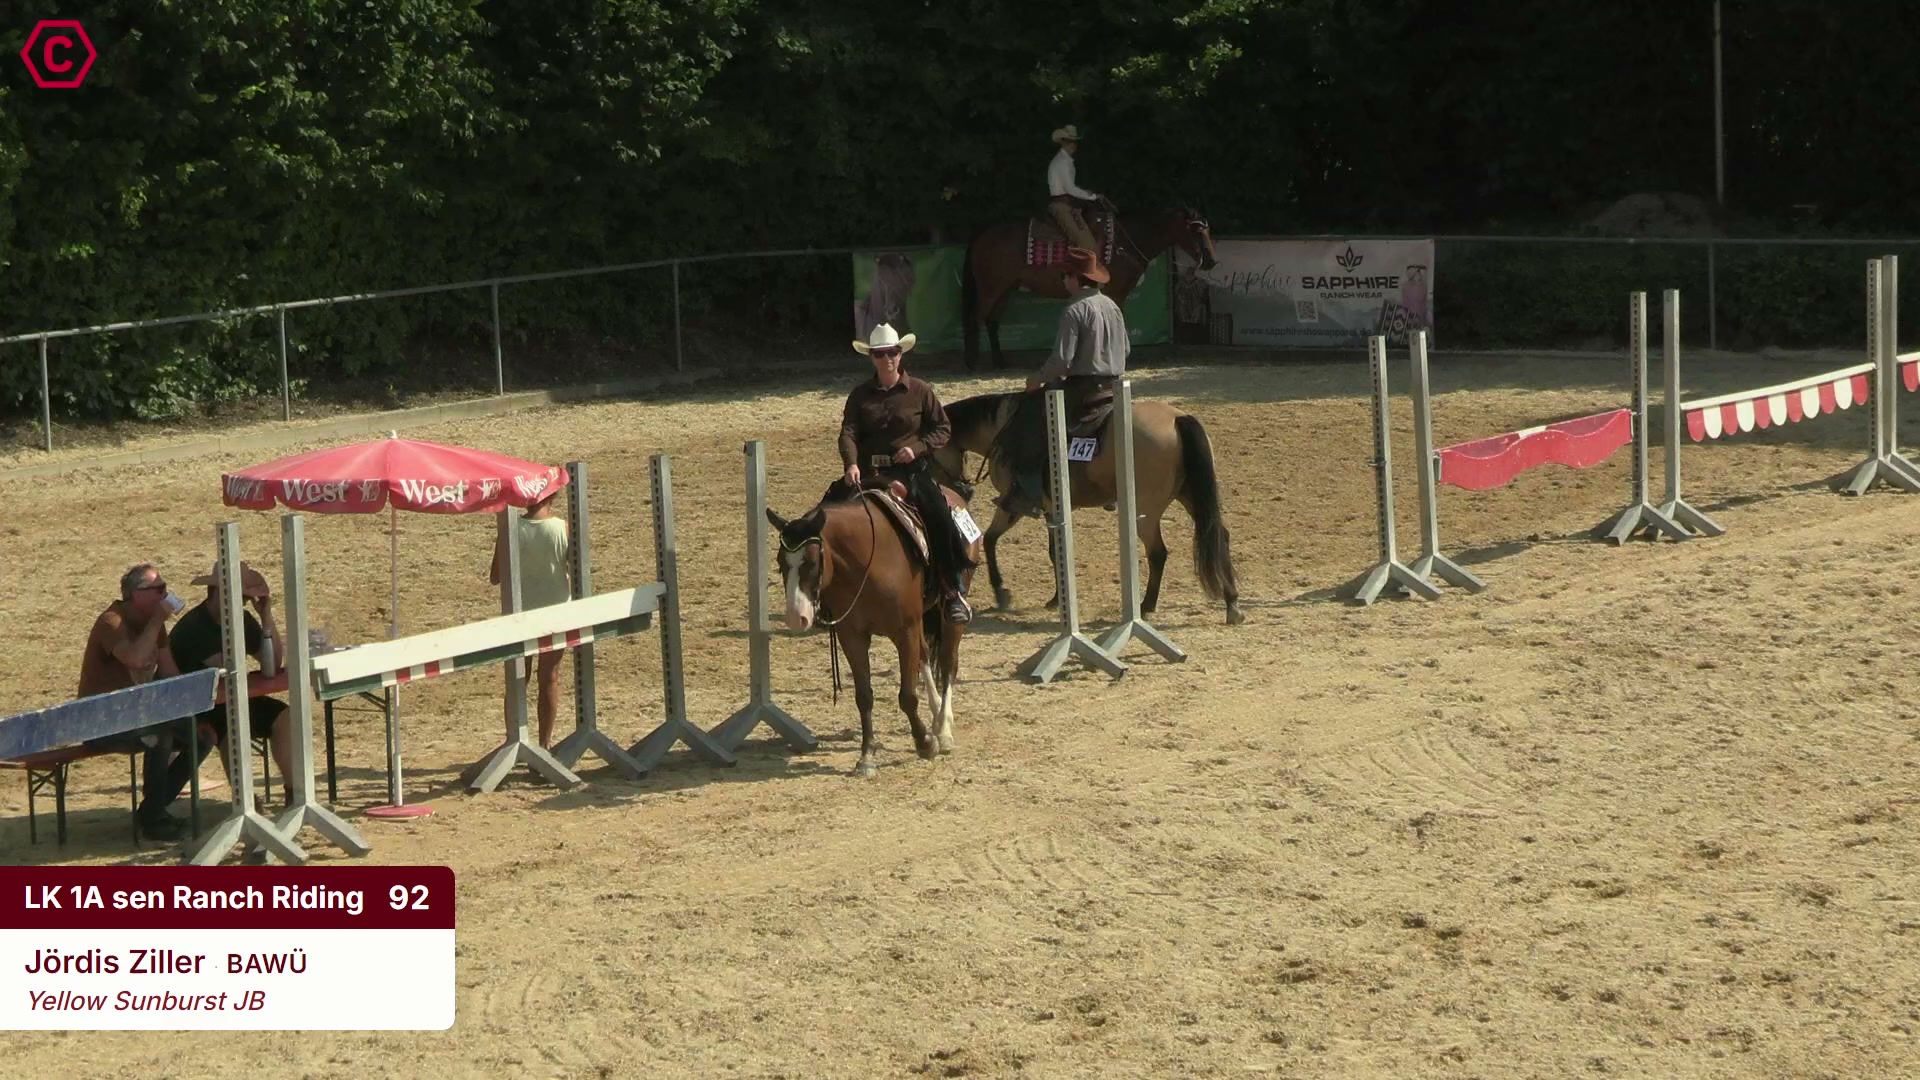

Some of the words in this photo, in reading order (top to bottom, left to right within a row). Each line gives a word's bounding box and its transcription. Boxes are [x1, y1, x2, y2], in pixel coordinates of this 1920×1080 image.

[1302, 276, 1400, 289] SAPPHIRE
[1072, 441, 1094, 458] 147
[282, 478, 351, 504] West
[399, 478, 469, 505] West
